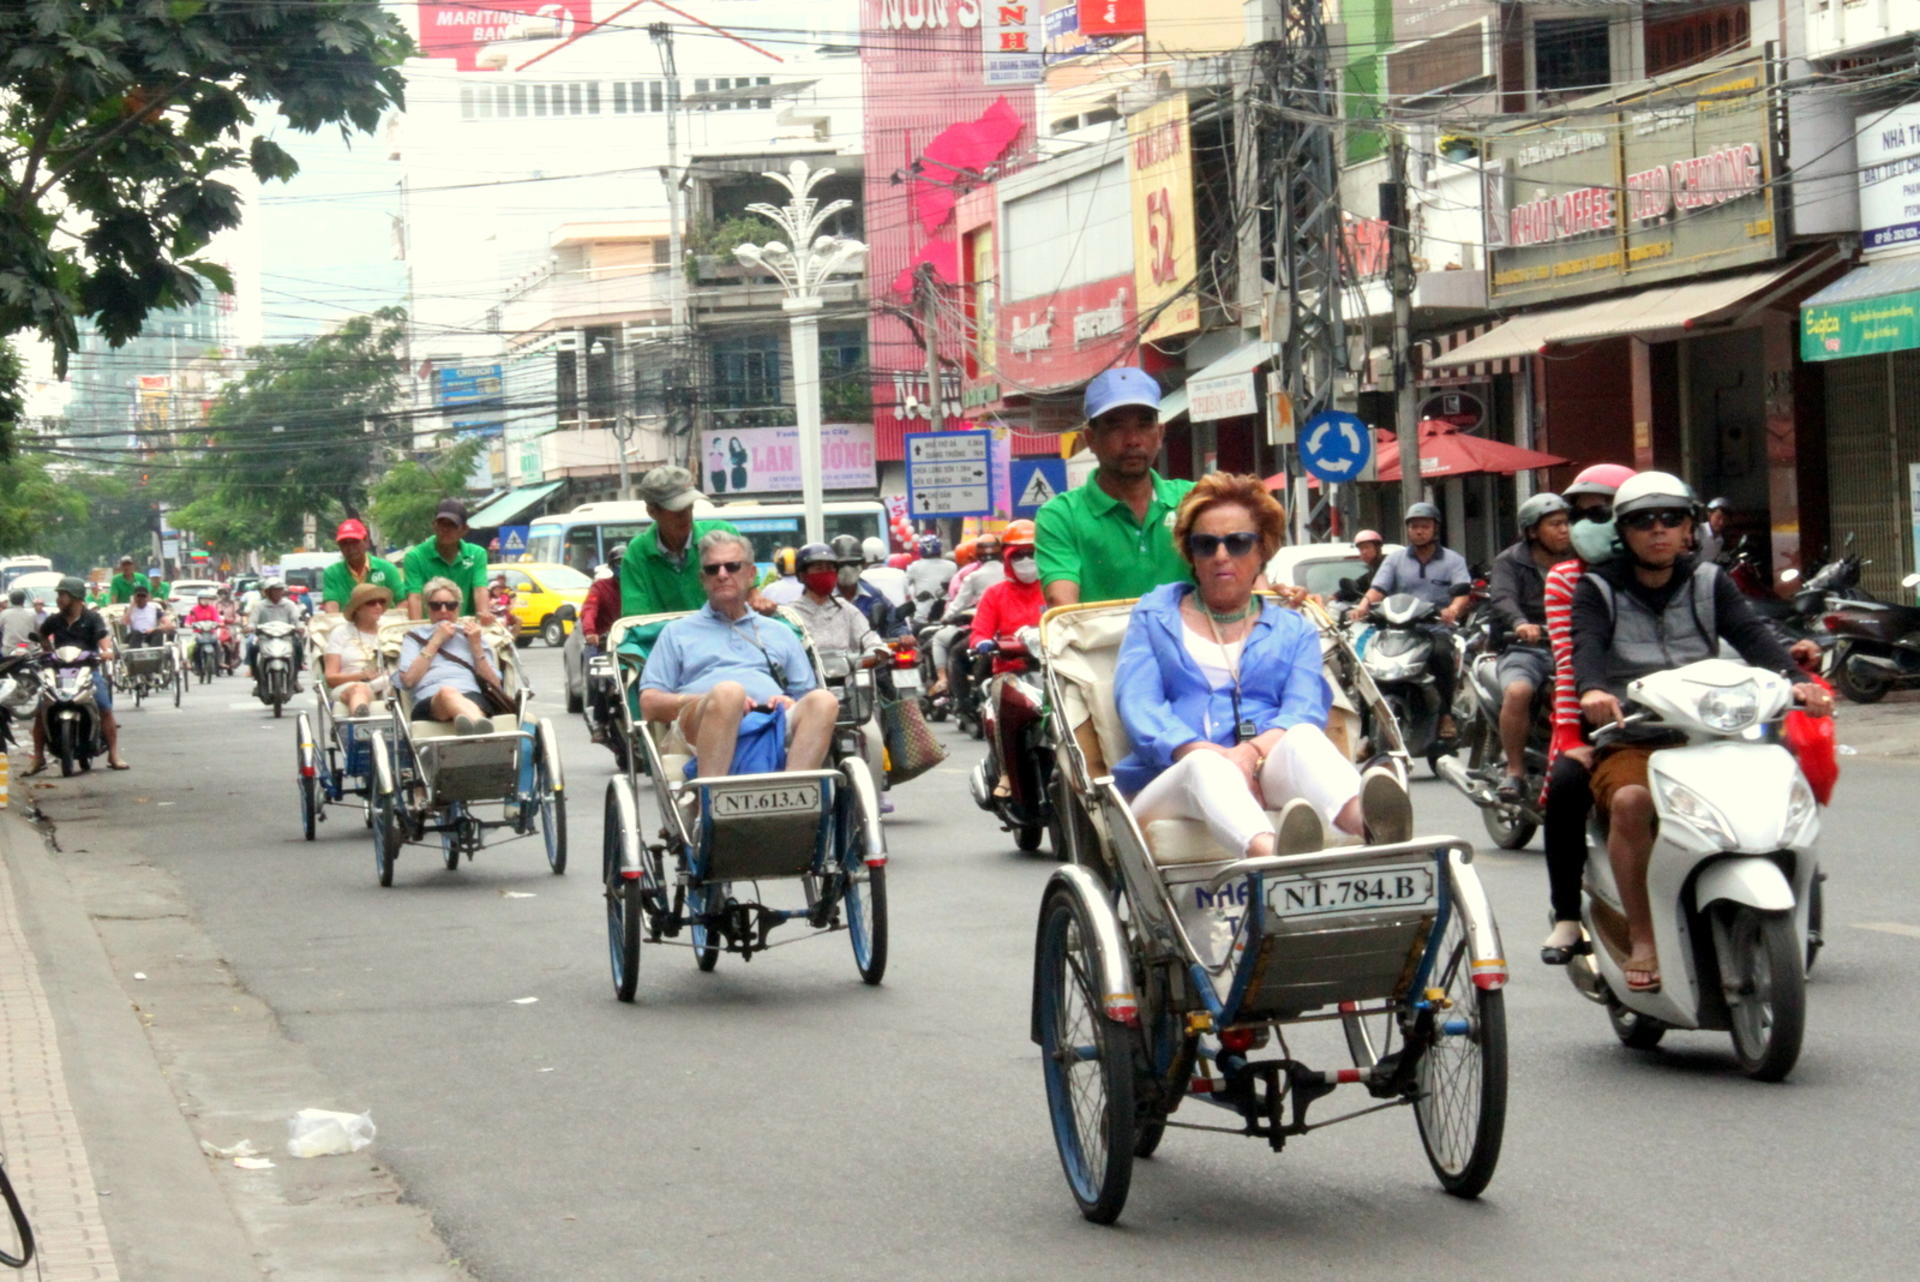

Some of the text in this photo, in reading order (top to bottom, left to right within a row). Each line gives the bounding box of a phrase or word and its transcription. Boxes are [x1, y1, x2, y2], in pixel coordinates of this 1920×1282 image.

[1882, 123, 1905, 150] NHÀ
[751, 446, 794, 472] LAN
[726, 791, 808, 811] NT.613.A
[1284, 876, 1415, 910] NT.784.B
